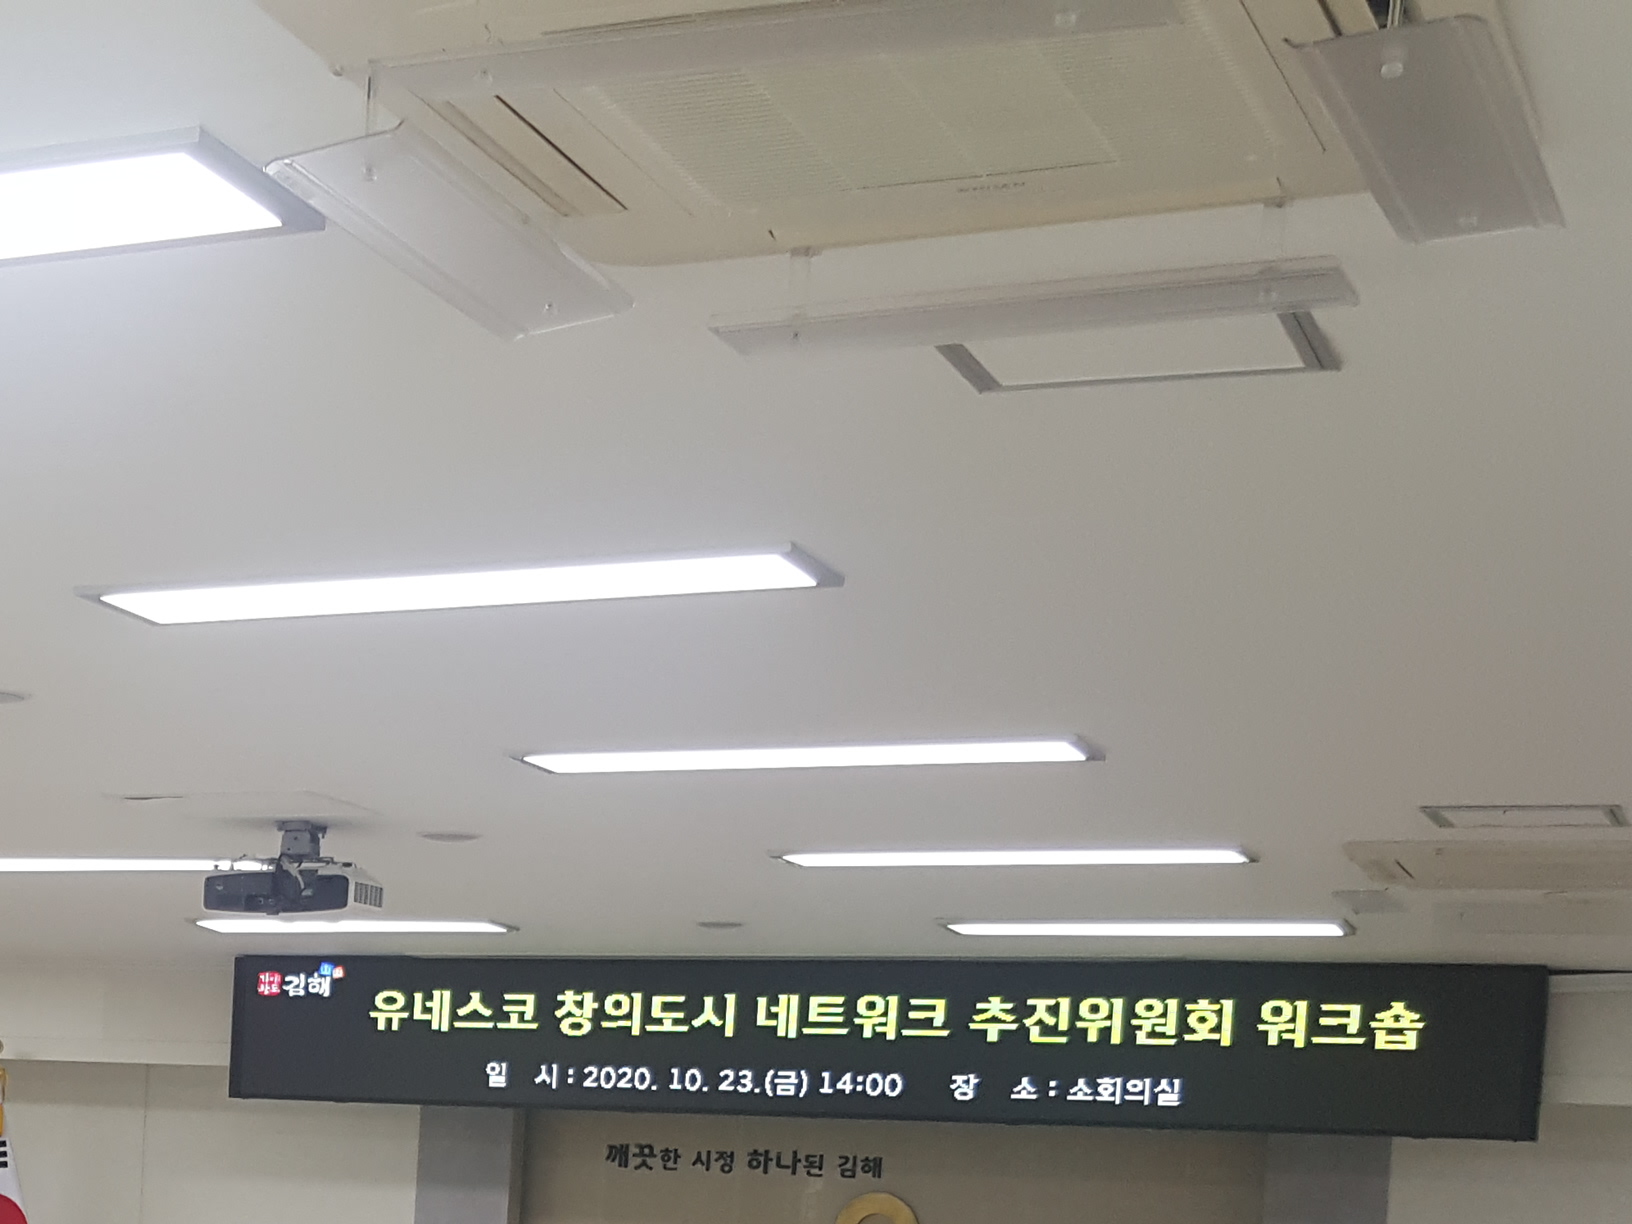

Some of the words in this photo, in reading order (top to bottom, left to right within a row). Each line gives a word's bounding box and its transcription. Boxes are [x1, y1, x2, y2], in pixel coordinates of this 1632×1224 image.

[282, 971, 331, 997] 김해
[368, 988, 539, 1033] 유네스코
[554, 989, 736, 1038] 창의도시
[755, 993, 951, 1041] 네트워크
[966, 996, 1234, 1047] 추진위원회
[1255, 1000, 1427, 1051] 워크숍
[668, 1067, 709, 1092] 10.
[717, 1068, 809, 1098] 23.(금)
[818, 1071, 904, 1098] 14:00
[1066, 1076, 1183, 1107] 소회의실
[604, 1142, 682, 1172] 깨끗한
[691, 1149, 736, 1173] 시정
[746, 1149, 825, 1178] 하나된
[836, 1154, 884, 1180] 김해
